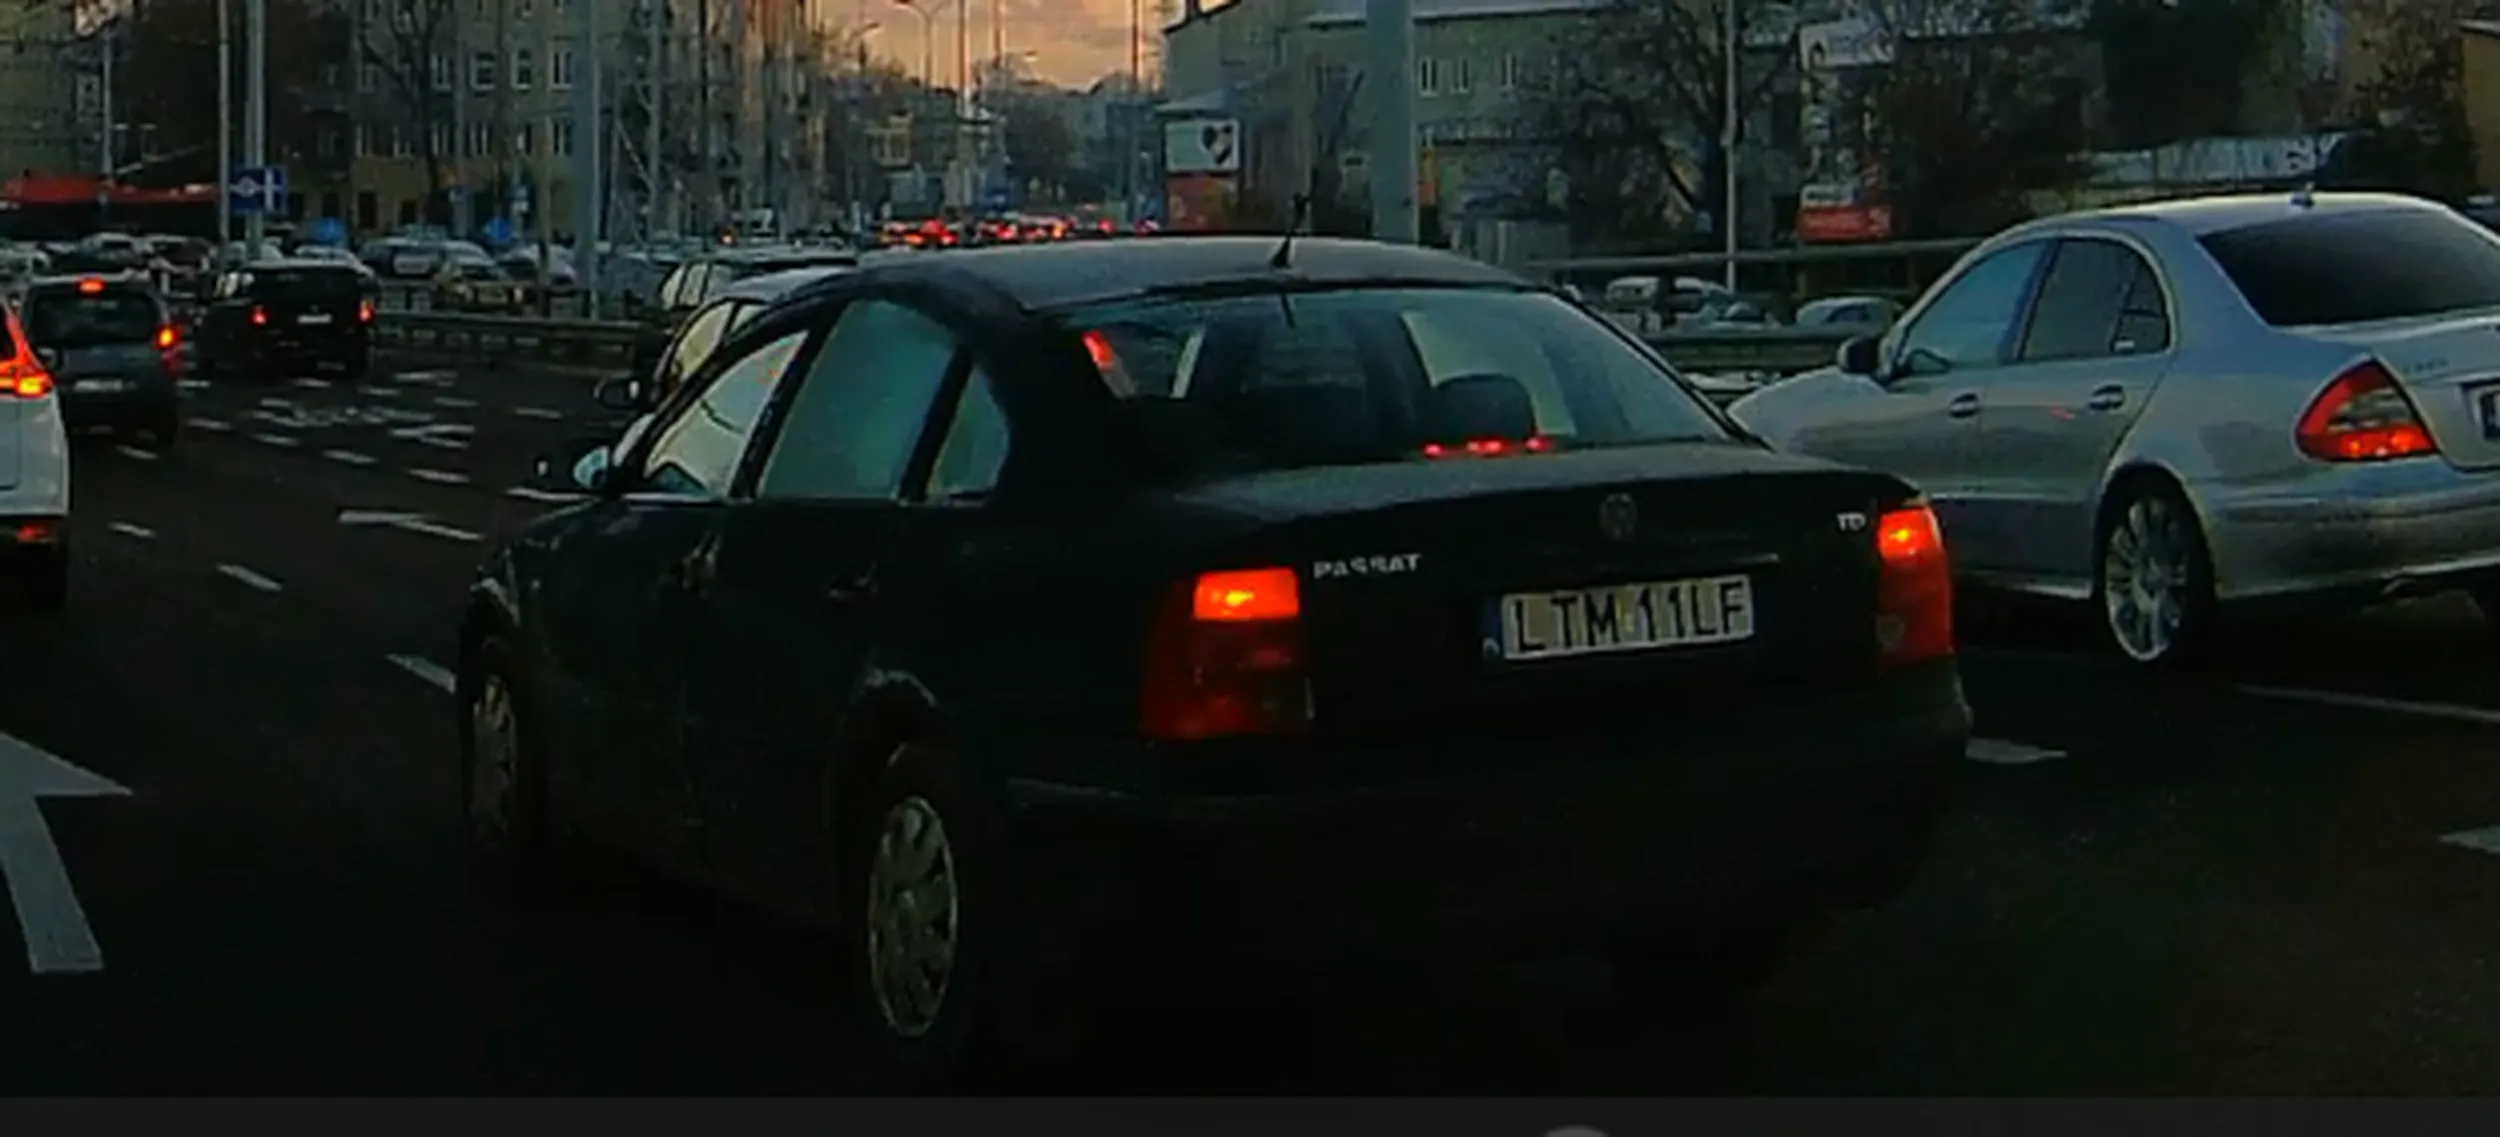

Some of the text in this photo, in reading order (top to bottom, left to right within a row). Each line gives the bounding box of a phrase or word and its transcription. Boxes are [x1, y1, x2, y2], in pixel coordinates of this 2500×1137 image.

[1313, 553, 1421, 579] PASSAT
[1515, 581, 1744, 650] LTM 11LF
